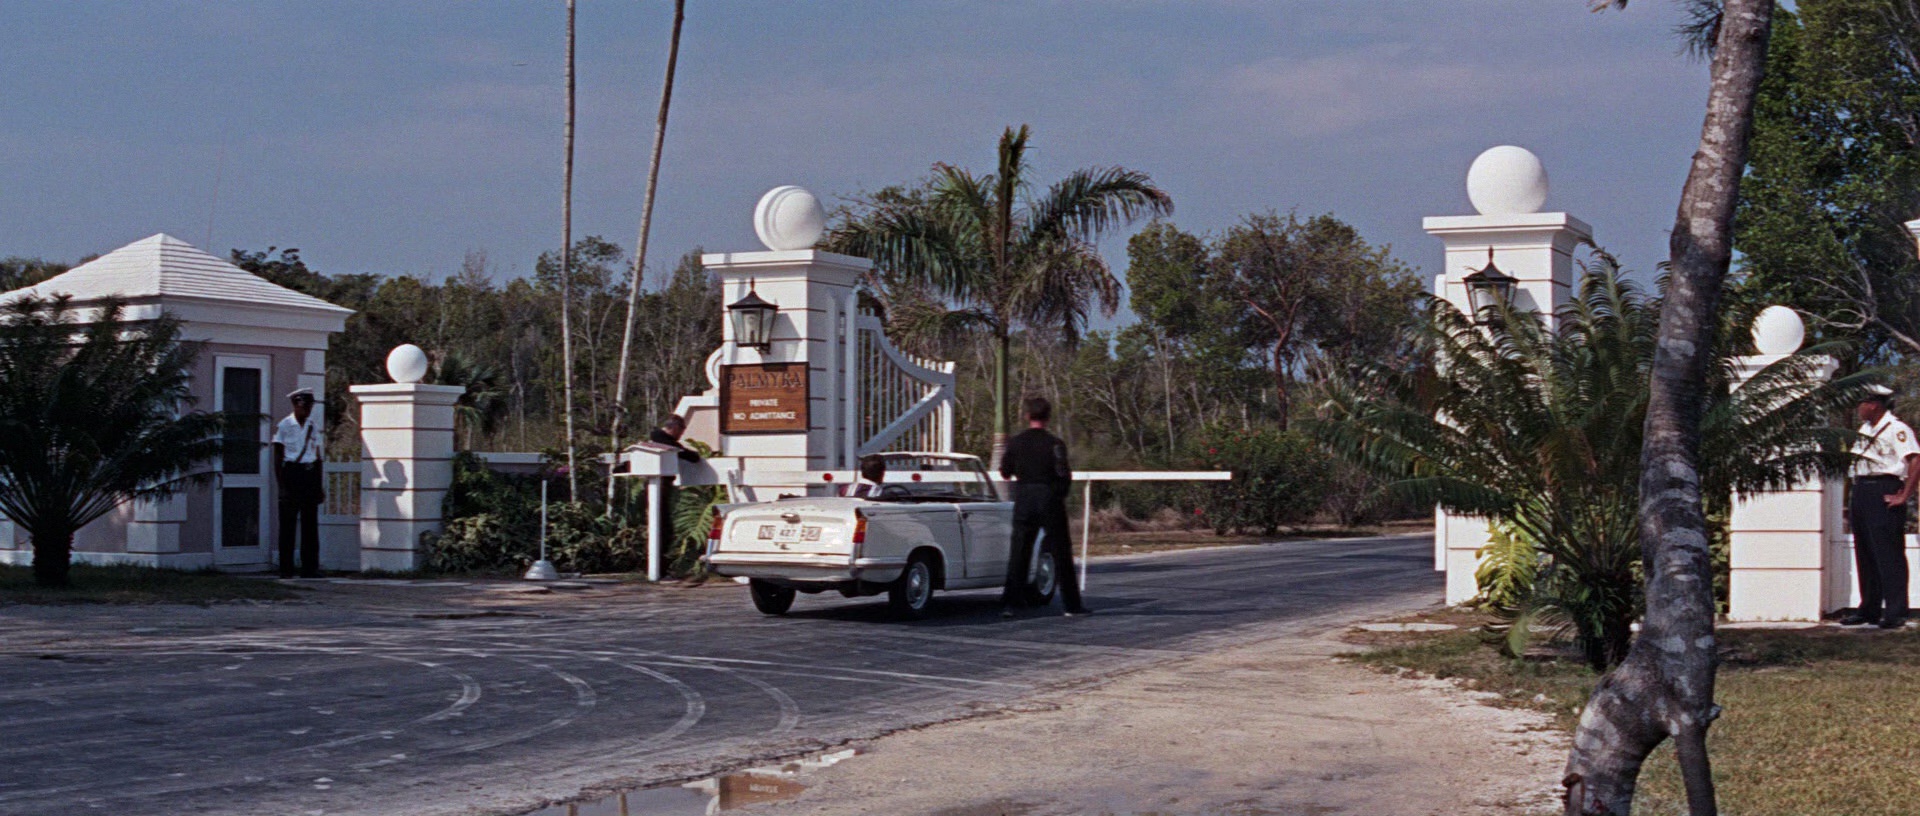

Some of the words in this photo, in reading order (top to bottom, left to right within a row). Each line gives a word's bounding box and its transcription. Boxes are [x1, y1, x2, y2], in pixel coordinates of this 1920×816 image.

[727, 371, 804, 389] PALMYRA
[750, 399, 778, 407] PRIVATE
[733, 412, 747, 420] NO
[750, 411, 797, 420] ADMITTANCE
